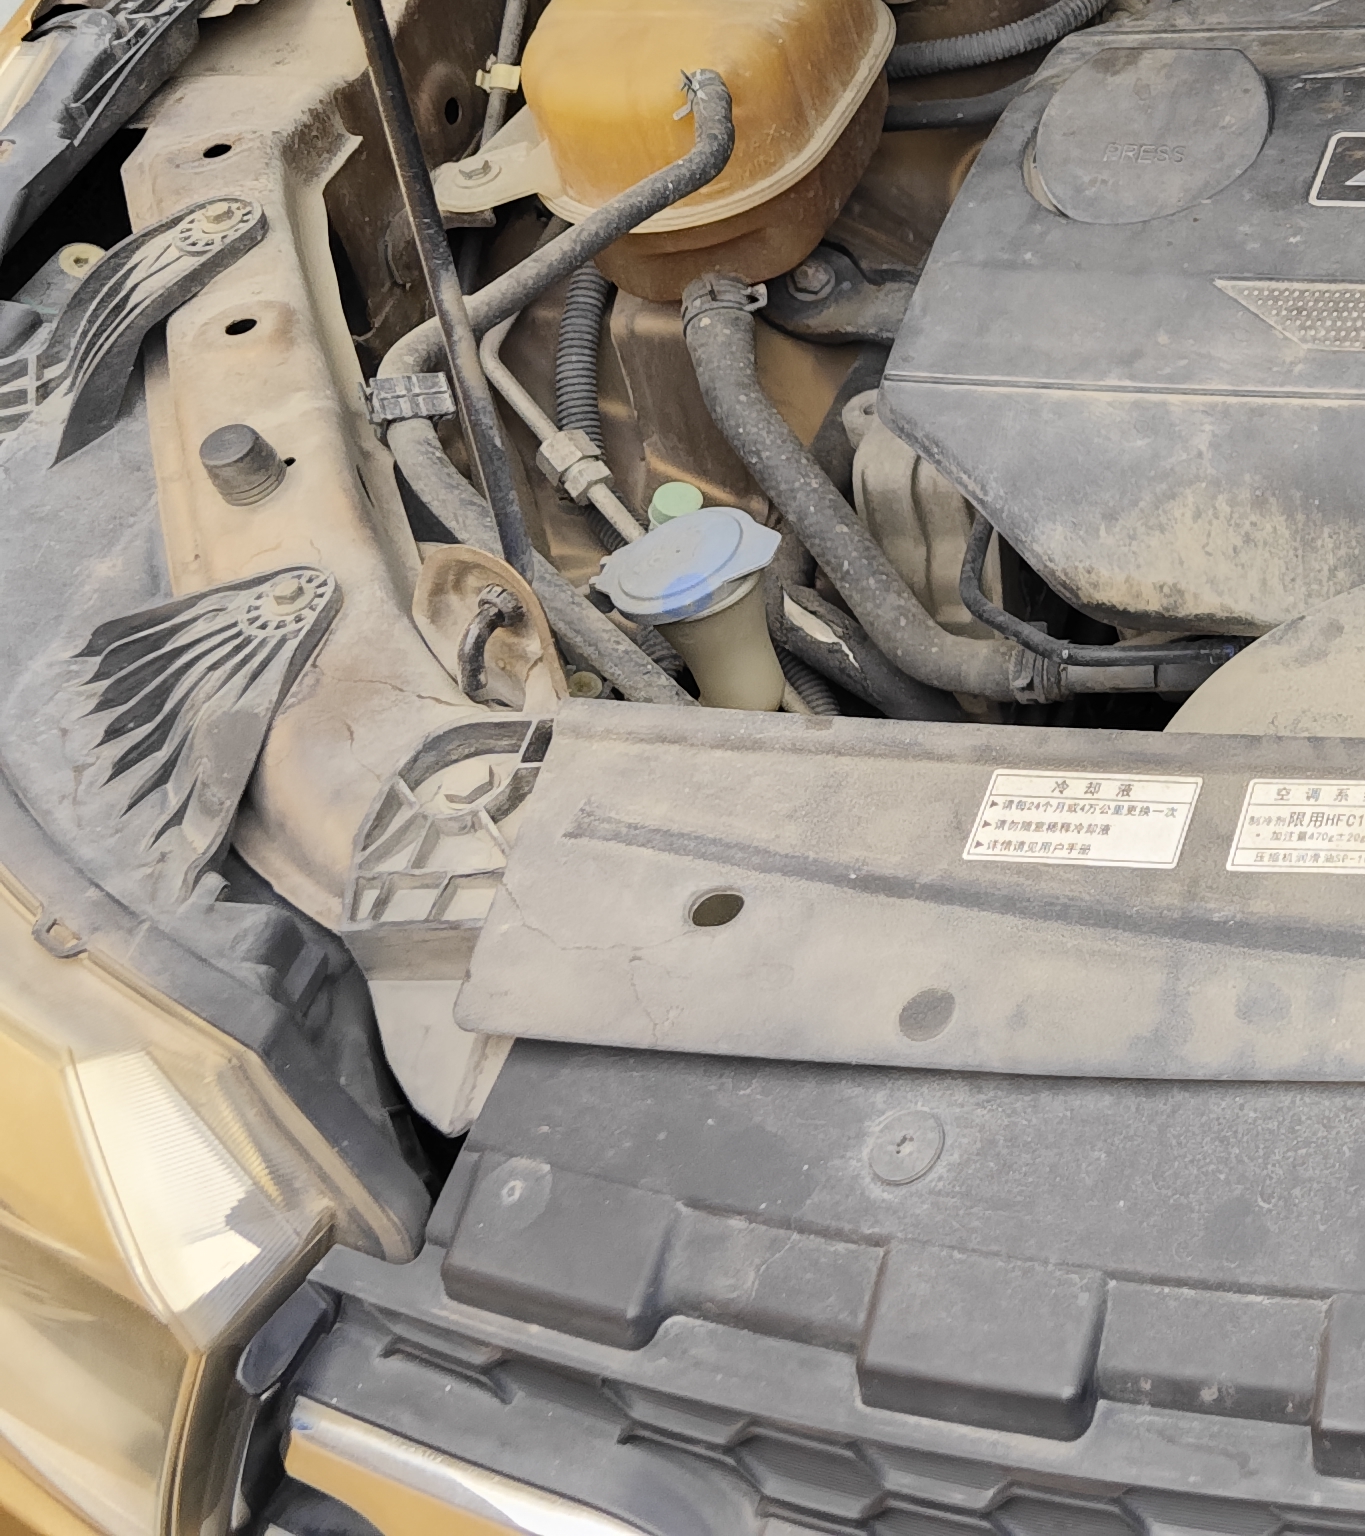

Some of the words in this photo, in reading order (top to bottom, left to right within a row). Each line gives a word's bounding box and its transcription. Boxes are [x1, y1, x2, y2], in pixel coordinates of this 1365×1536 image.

[1102, 142, 1187, 163] PRESS
[1050, 779, 1134, 798] 冷却液
